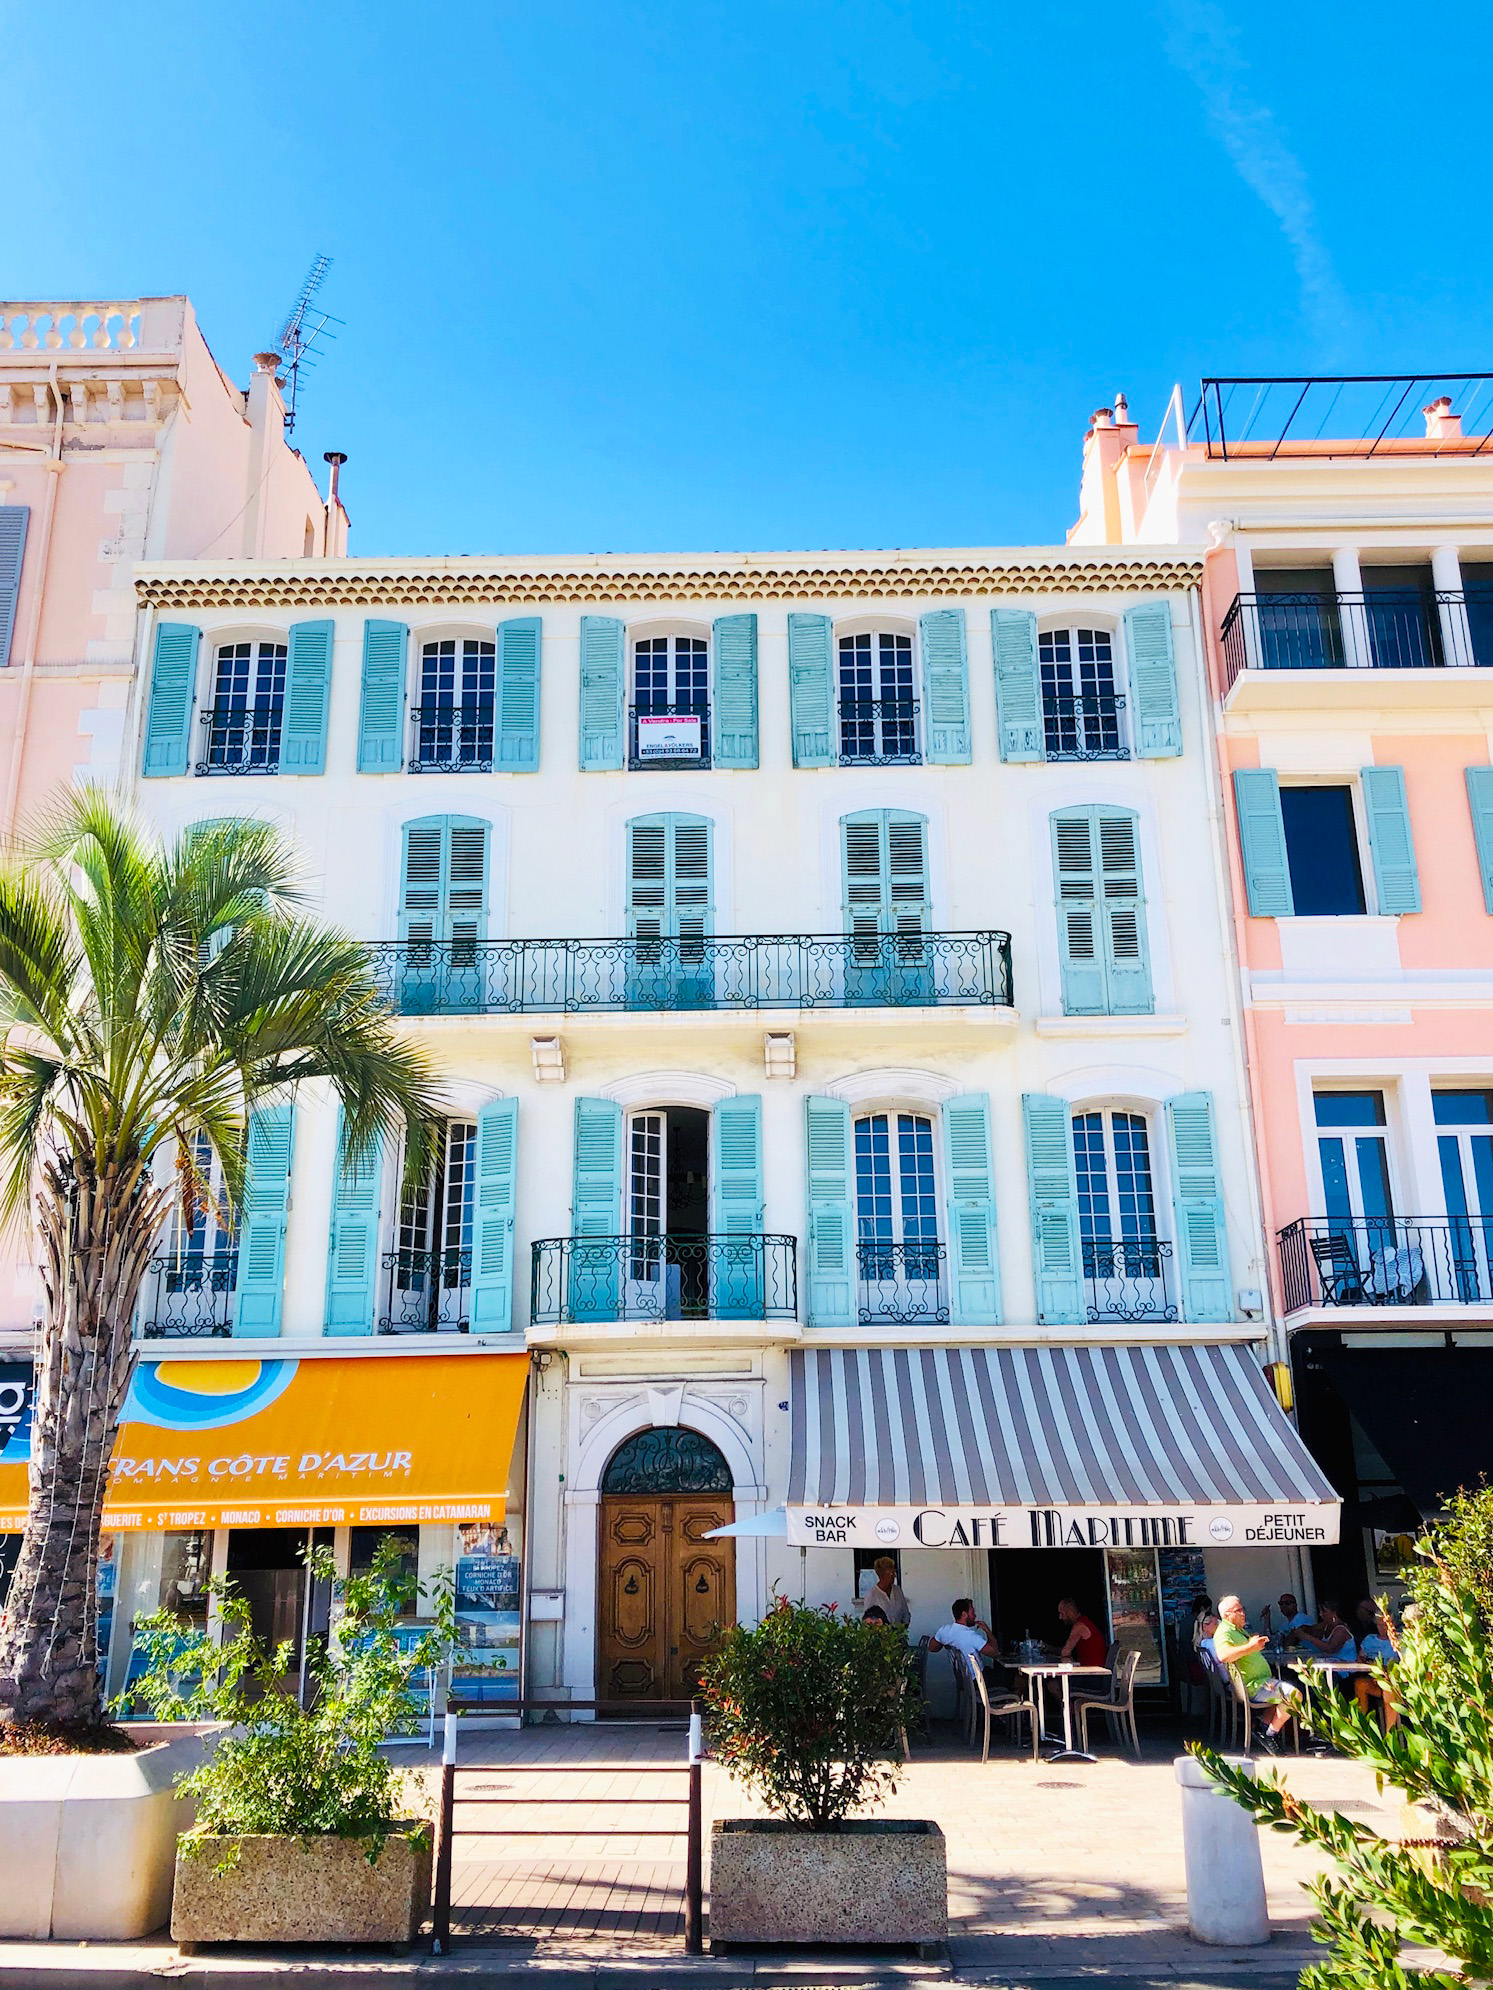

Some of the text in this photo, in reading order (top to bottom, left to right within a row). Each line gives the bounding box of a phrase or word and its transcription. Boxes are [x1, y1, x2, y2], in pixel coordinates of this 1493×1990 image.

[208, 1454, 290, 1476] CÔTE
[298, 1451, 412, 1472] D'AZUR
[112, 1469, 411, 1485] OMPAGNIE MARITIME
[0, 1516, 12, 1529] ES
[169, 1512, 206, 1526] TROPEZ
[221, 1510, 260, 1524] MONACO
[275, 1510, 320, 1523] CORNICHE
[322, 1508, 344, 1522] D'OR
[359, 1506, 418, 1521] EXCURSIONS
[419, 1505, 431, 1519] EN
[433, 1504, 491, 1519] CATAMARAN
[805, 1516, 856, 1528] SNACK
[1264, 1514, 1305, 1526] PETIT
[816, 1530, 846, 1542] BAR
[1245, 1526, 1325, 1540] DÉJEUNER
[464, 1571, 496, 1579] CORNICHE
